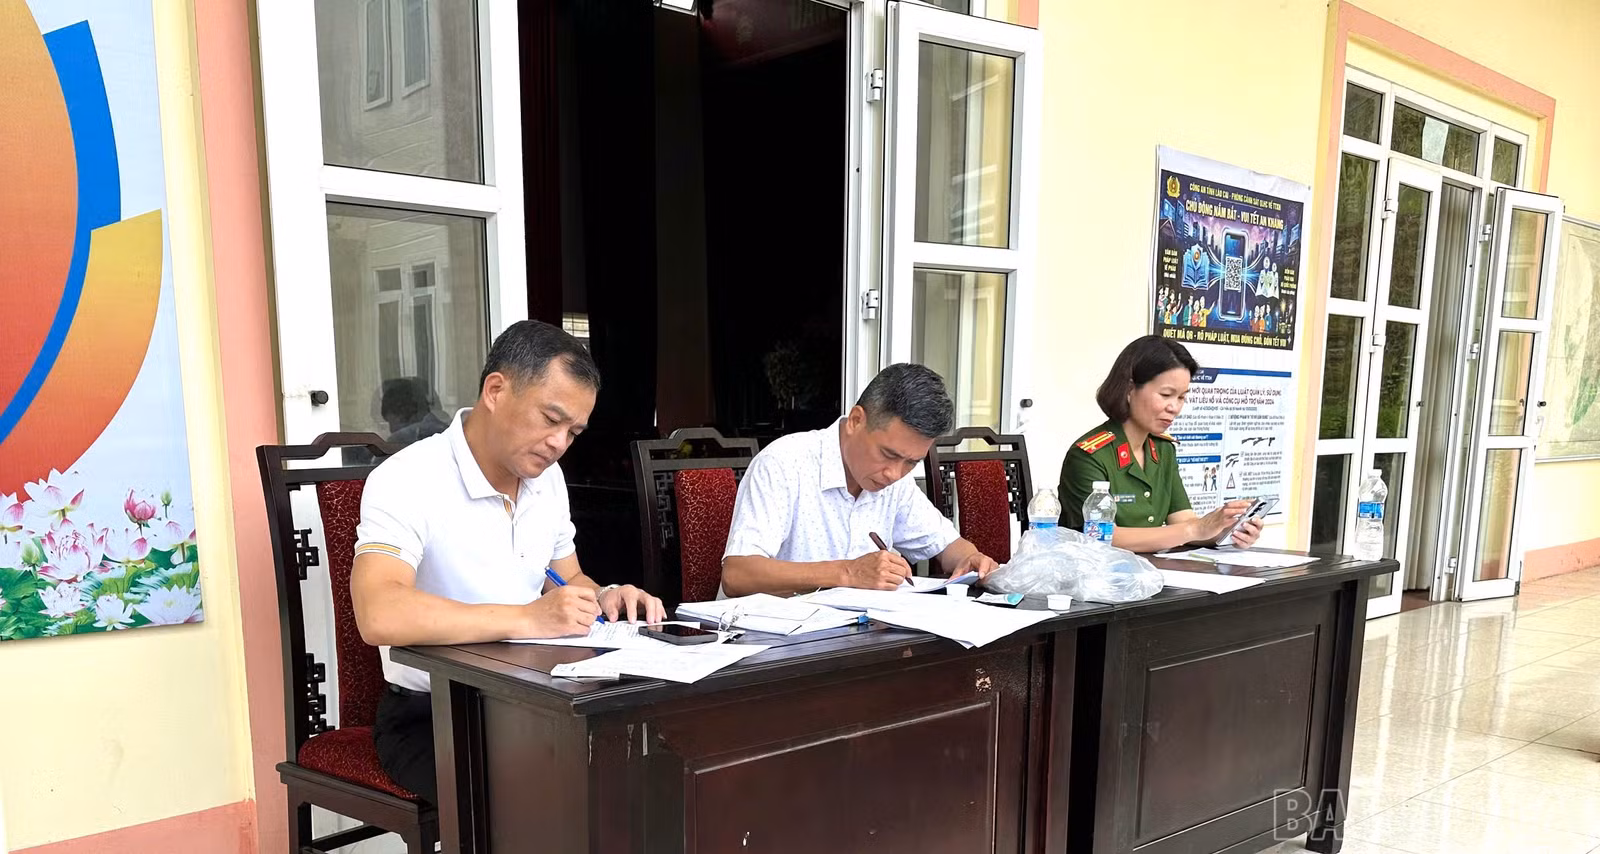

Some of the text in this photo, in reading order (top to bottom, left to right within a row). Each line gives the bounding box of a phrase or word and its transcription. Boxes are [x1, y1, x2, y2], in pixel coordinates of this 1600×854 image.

[1186, 198, 1197, 212] CHỦ
[1198, 201, 1213, 216] ĐỘNG
[1214, 203, 1226, 218] NẮM
[1227, 206, 1237, 220] BẮT
[1241, 211, 1250, 224] VUI
[1250, 211, 1260, 225] TẾT
[1260, 216, 1267, 226] AN
[1268, 217, 1284, 230] KHANG
[1163, 328, 1177, 339] QUÉT
[1177, 329, 1185, 339] MÃ
[1204, 331, 1217, 342] PHÁP
